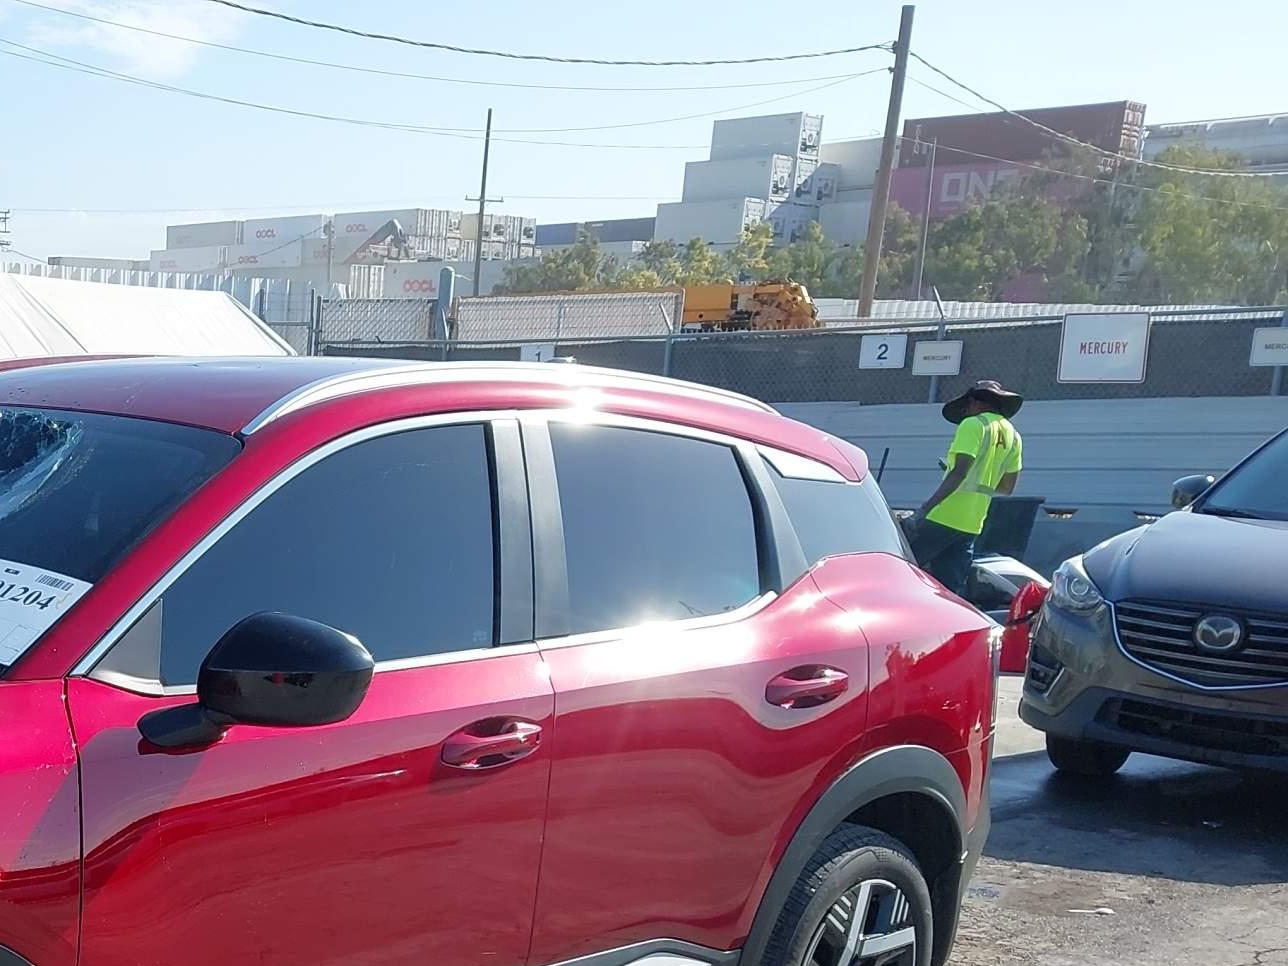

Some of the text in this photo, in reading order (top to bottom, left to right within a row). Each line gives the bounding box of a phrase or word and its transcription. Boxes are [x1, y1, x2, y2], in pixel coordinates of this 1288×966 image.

[255, 229, 276, 239] OOCL
[403, 280, 437, 293] OOCL
[876, 343, 889, 360] 2
[1079, 341, 1128, 355] MERCURY
